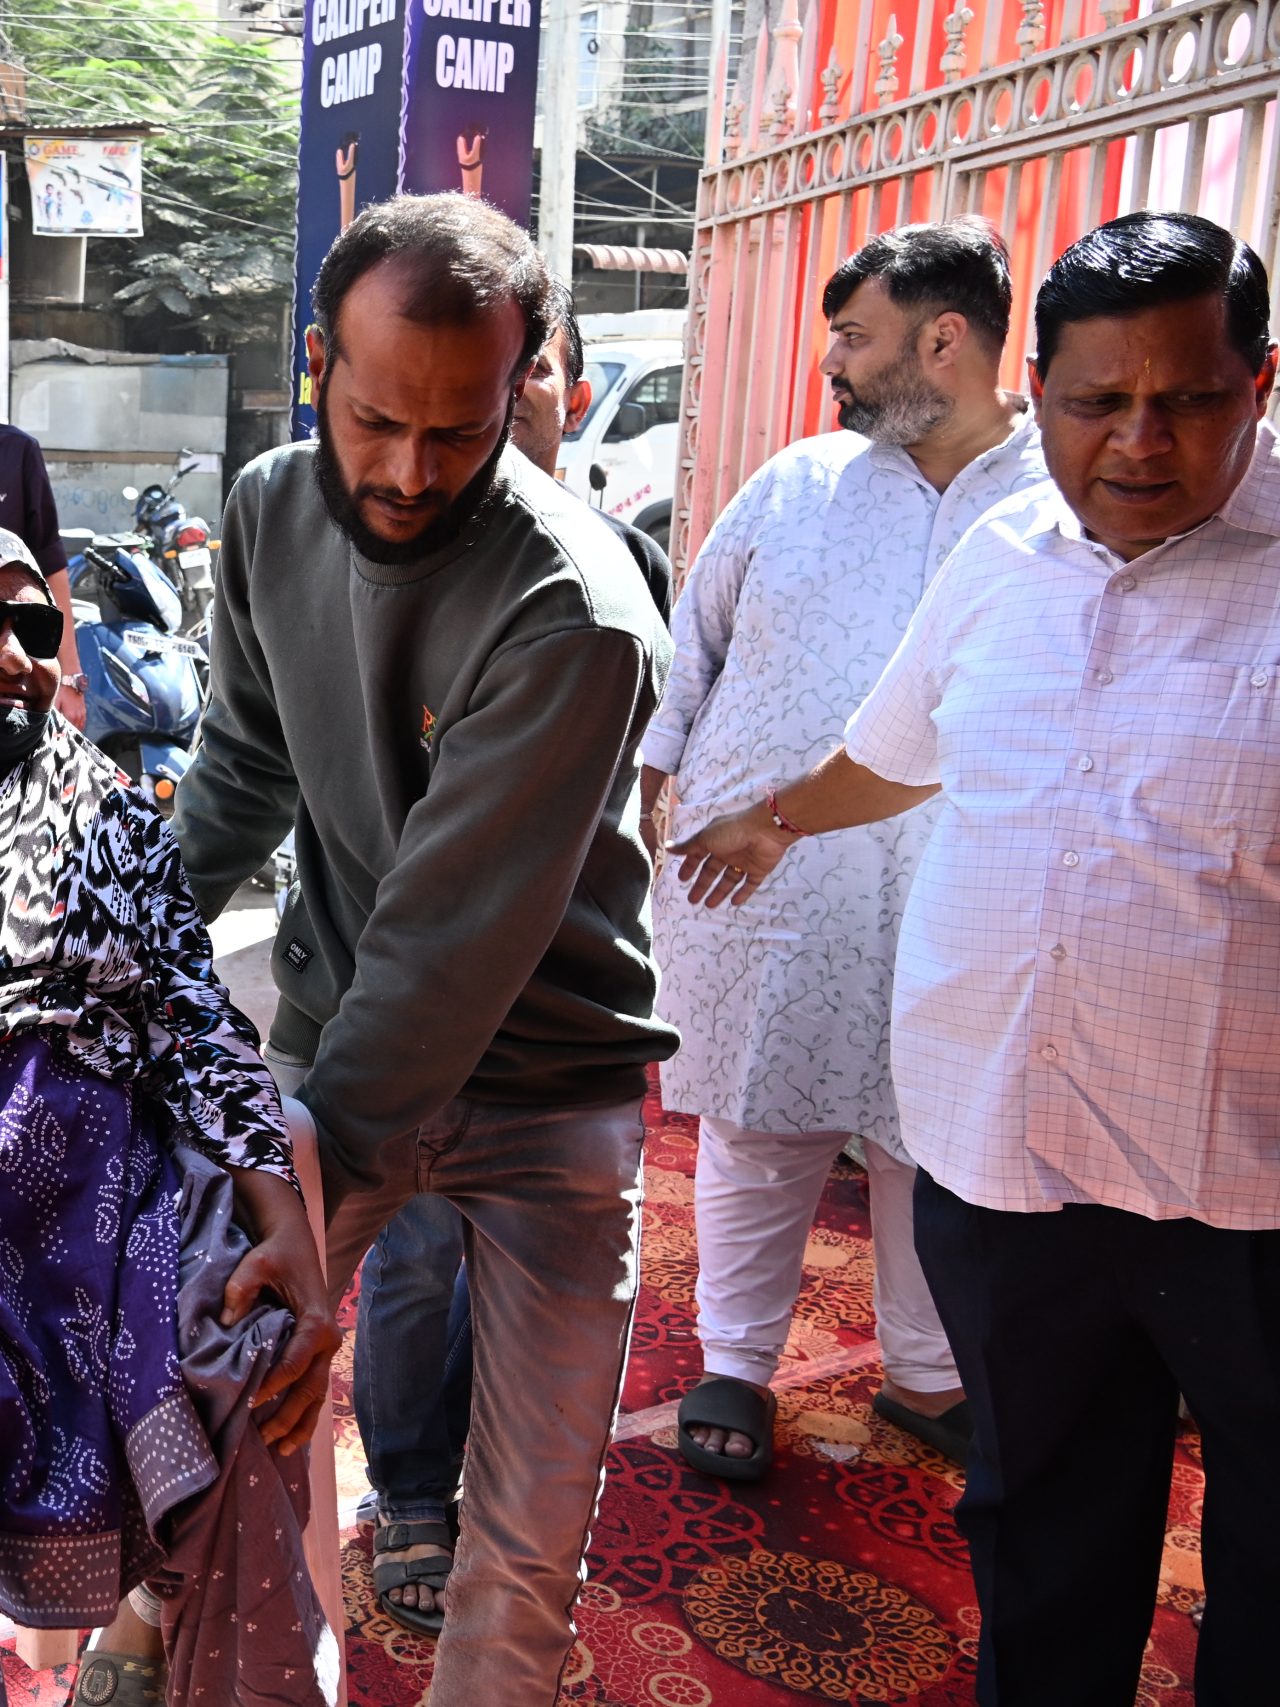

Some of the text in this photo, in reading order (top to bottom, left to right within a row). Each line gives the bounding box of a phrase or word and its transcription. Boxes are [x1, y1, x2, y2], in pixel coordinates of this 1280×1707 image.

[320, 42, 383, 108] CAMP
[435, 34, 515, 93] CAMP
[290, 943, 308, 959] ONLY
